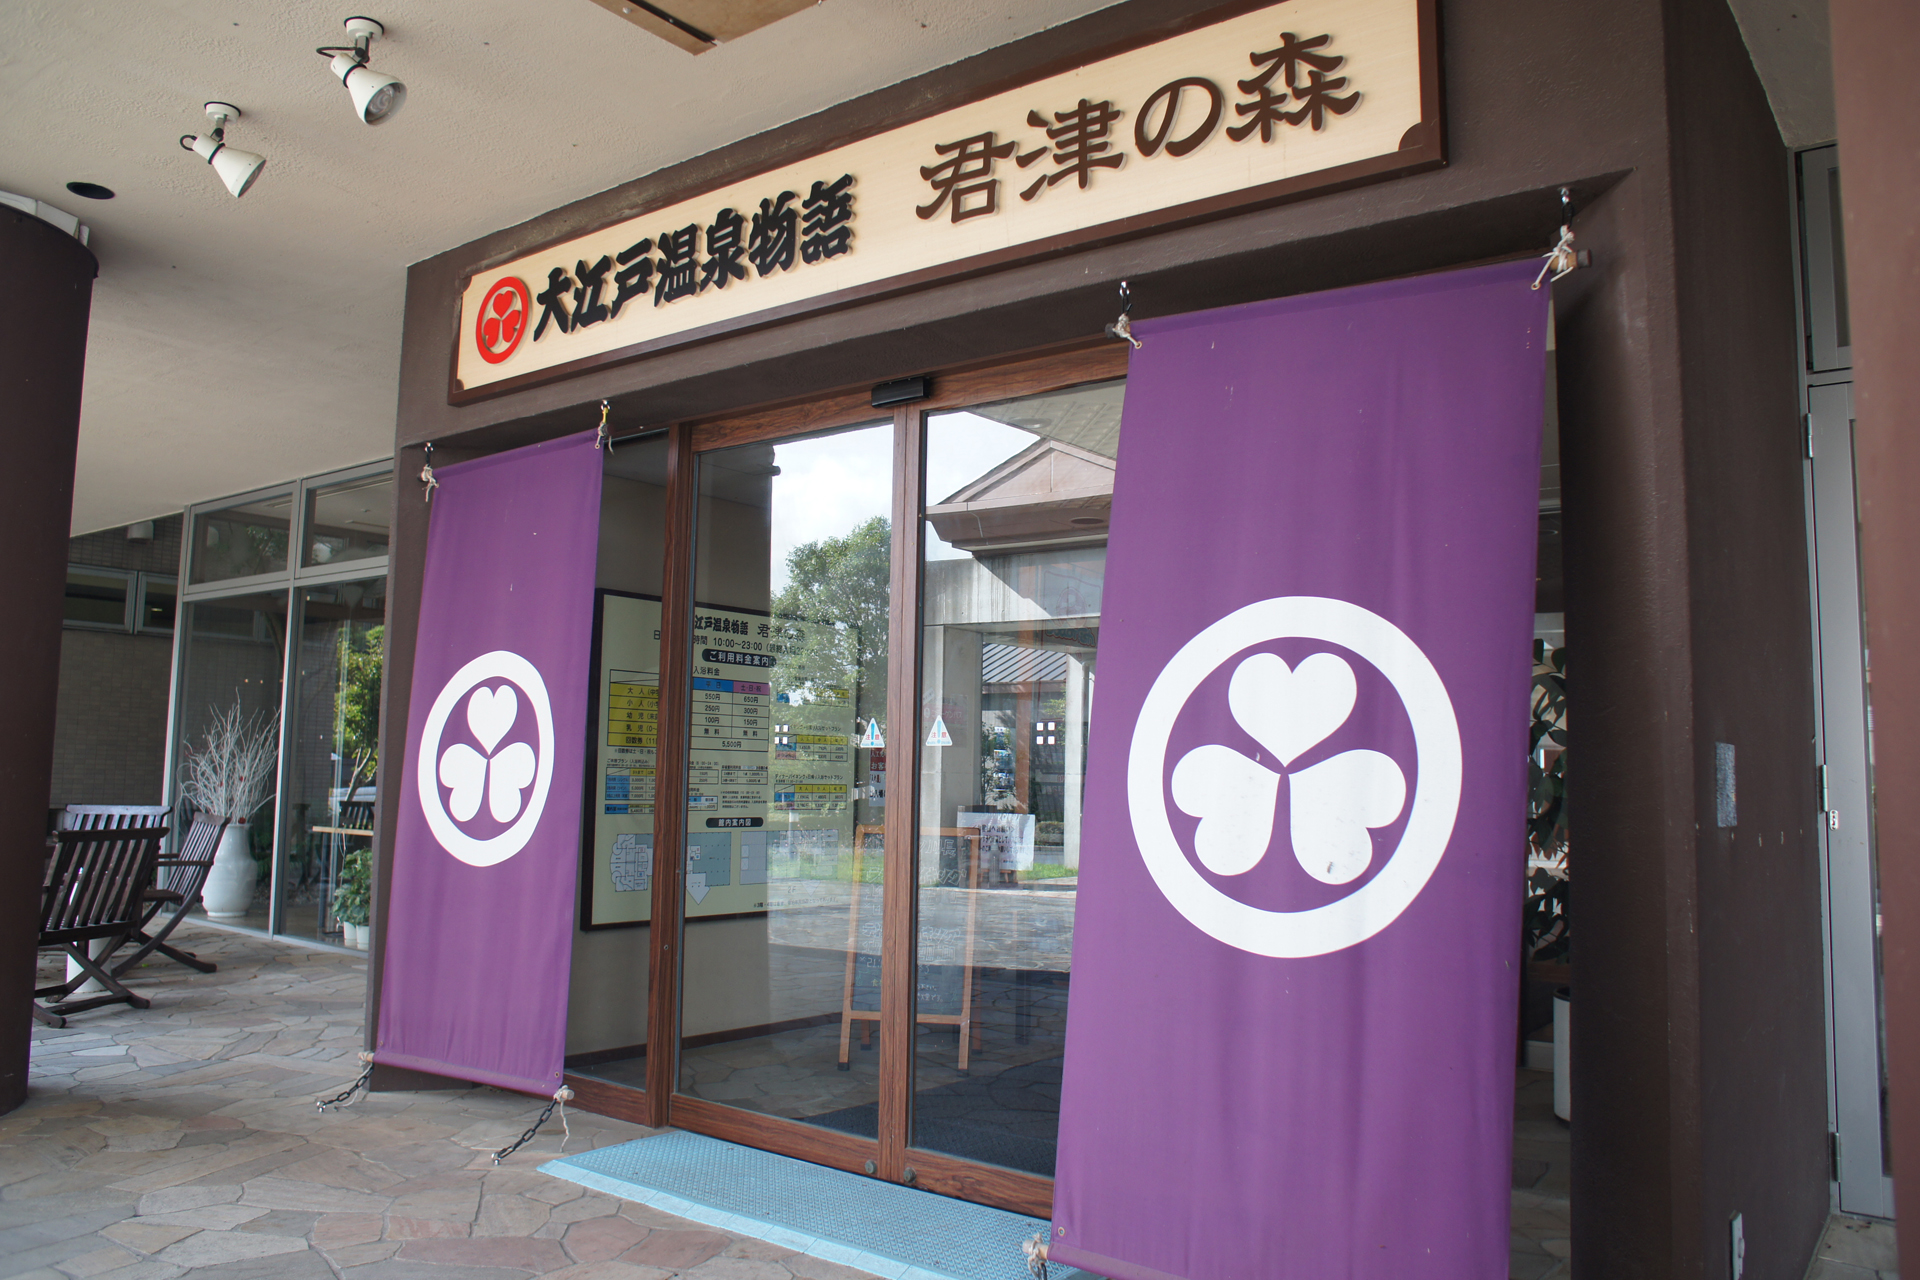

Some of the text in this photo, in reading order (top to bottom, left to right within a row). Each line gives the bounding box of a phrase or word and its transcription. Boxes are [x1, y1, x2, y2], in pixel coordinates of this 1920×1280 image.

[533, 32, 1361, 342] 大江戸温泉物語 君津の森
[709, 651, 769, 666] ご利用料金案内
[693, 666, 720, 676] 入浴料金
[743, 707, 758, 715] 300円
[704, 716, 720, 724] 100円
[721, 740, 742, 748] 5,500円
[718, 818, 752, 827] 館内案内図
